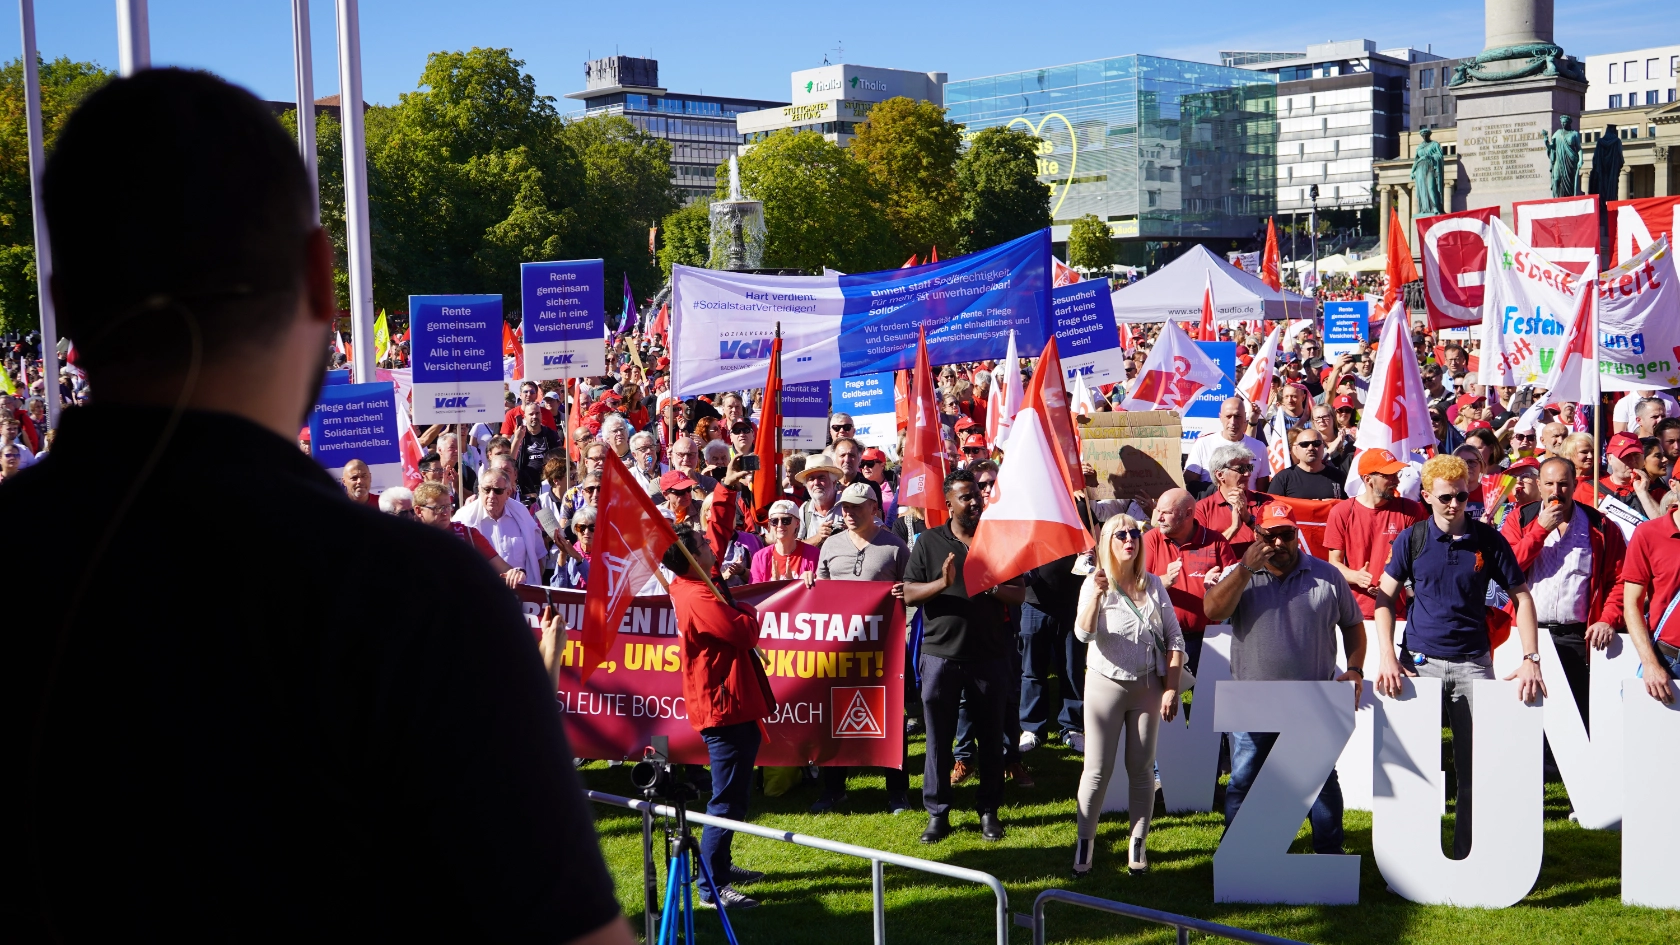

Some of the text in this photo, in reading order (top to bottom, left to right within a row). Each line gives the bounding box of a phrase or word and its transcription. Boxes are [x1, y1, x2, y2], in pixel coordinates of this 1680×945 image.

[816, 79, 841, 91] Thalia
[860, 79, 886, 91] Thalia
[784, 103, 829, 116] STUTTGARTER
[791, 112, 821, 122] ZEITUNG
[1464, 136, 1498, 146] KOENIG
[550, 272, 577, 281] Rente
[537, 285, 589, 296] gemeinsam
[871, 285, 906, 297] Einheit
[908, 280, 931, 292] statt
[932, 280, 1011, 300] unverhandelbar!
[546, 298, 581, 307] sichern.
[746, 292, 817, 302] Hart verdient.
[870, 298, 886, 307] Für
[441, 307, 472, 315] Rente
[693, 300, 816, 314] #SozialstaatVerteidigen!
[1055, 302, 1096, 316] darf keine
[540, 309, 588, 319] Alle in eine
[1058, 313, 1097, 327] Frage des
[427, 321, 486, 331] gemeinsam
[534, 320, 594, 333] Versicherung!
[864, 325, 878, 334] Wir
[879, 321, 909, 333] fordern
[912, 316, 950, 329] Solidarität
[961, 311, 984, 320] Rente,
[986, 307, 1012, 317] Pflege
[865, 336, 881, 345] und
[929, 326, 949, 335] durch
[951, 323, 962, 331] ein
[964, 319, 1013, 329] einheitliches
[1015, 317, 1030, 325] und
[1055, 323, 1103, 339] Geldbeutels
[438, 335, 477, 344] sichern.
[1072, 336, 1091, 347] sein!
[430, 348, 485, 357] Alle in eine
[867, 343, 916, 355] solidarisches
[543, 354, 574, 366] VdK
[1497, 338, 1534, 376] statt
[424, 361, 492, 371] Versicherung!
[782, 385, 809, 393] lidarität
[845, 381, 864, 389] Frage
[842, 388, 882, 399] Geldbeutels
[315, 400, 390, 413] Pflege darf nicht
[435, 397, 470, 408] VdK
[854, 400, 871, 408] sein!
[323, 413, 384, 425] arm machen!
[324, 425, 385, 438] Solidarität ist
[319, 438, 392, 451] unverhandelbar.
[624, 643, 682, 673] UNS
[761, 649, 885, 677] UKUNFT!
[632, 695, 690, 720] BOSC
[764, 702, 822, 724] BACH
